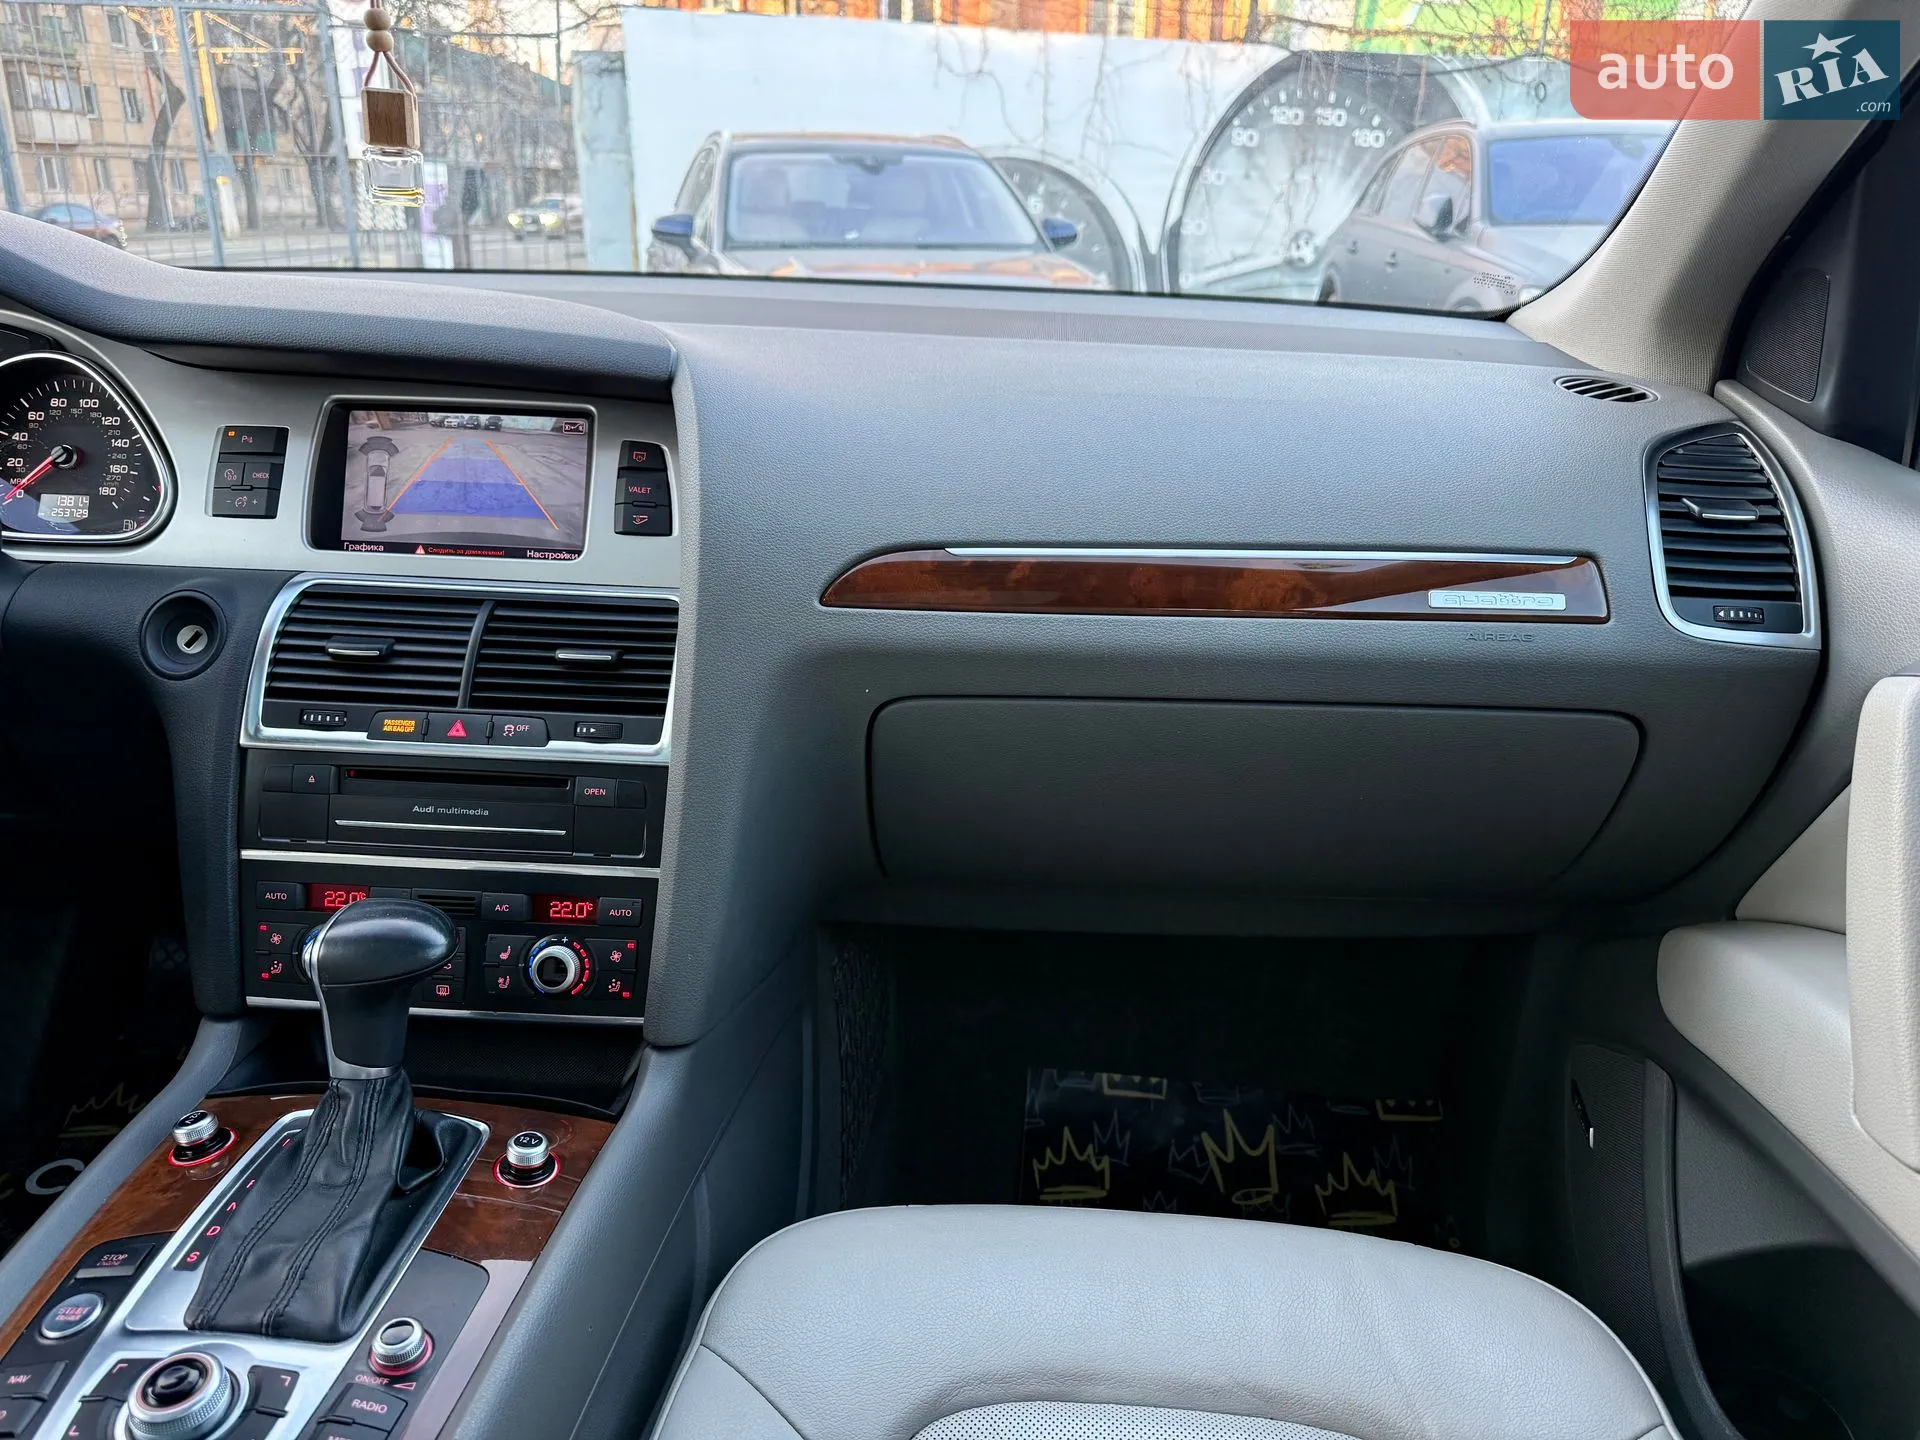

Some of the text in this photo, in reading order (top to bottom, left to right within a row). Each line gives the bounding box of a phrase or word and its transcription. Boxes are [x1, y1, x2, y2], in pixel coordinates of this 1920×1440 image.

[50, 398, 67, 407] 80
[79, 399, 99, 408] 100
[28, 412, 44, 420] 60
[101, 417, 120, 425] 120
[12, 432, 28, 441] 40
[111, 439, 129, 447] 140
[7, 458, 23, 467] 20
[109, 465, 128, 473] 160
[98, 487, 116, 496] 180
[628, 486, 652, 494] VALET
[343, 542, 385, 552] Графика
[526, 549, 579, 561] Настройки
[1443, 593, 1554, 607] quattro
[1465, 632, 1535, 643] AIRBAG
[584, 788, 606, 796] OPEN
[412, 805, 489, 816] Audi multimedia
[265, 892, 288, 900] AUTO
[494, 904, 510, 912] A/C
[609, 909, 632, 917] AUTO
[206, 1225, 221, 1236] D
[101, 1253, 128, 1261] STOP
[186, 1251, 200, 1262] S
[58, 1306, 92, 1315] START
[7, 1374, 32, 1385] NAV
[355, 1374, 390, 1386] ON/OFF
[351, 1398, 388, 1414] RADIO
